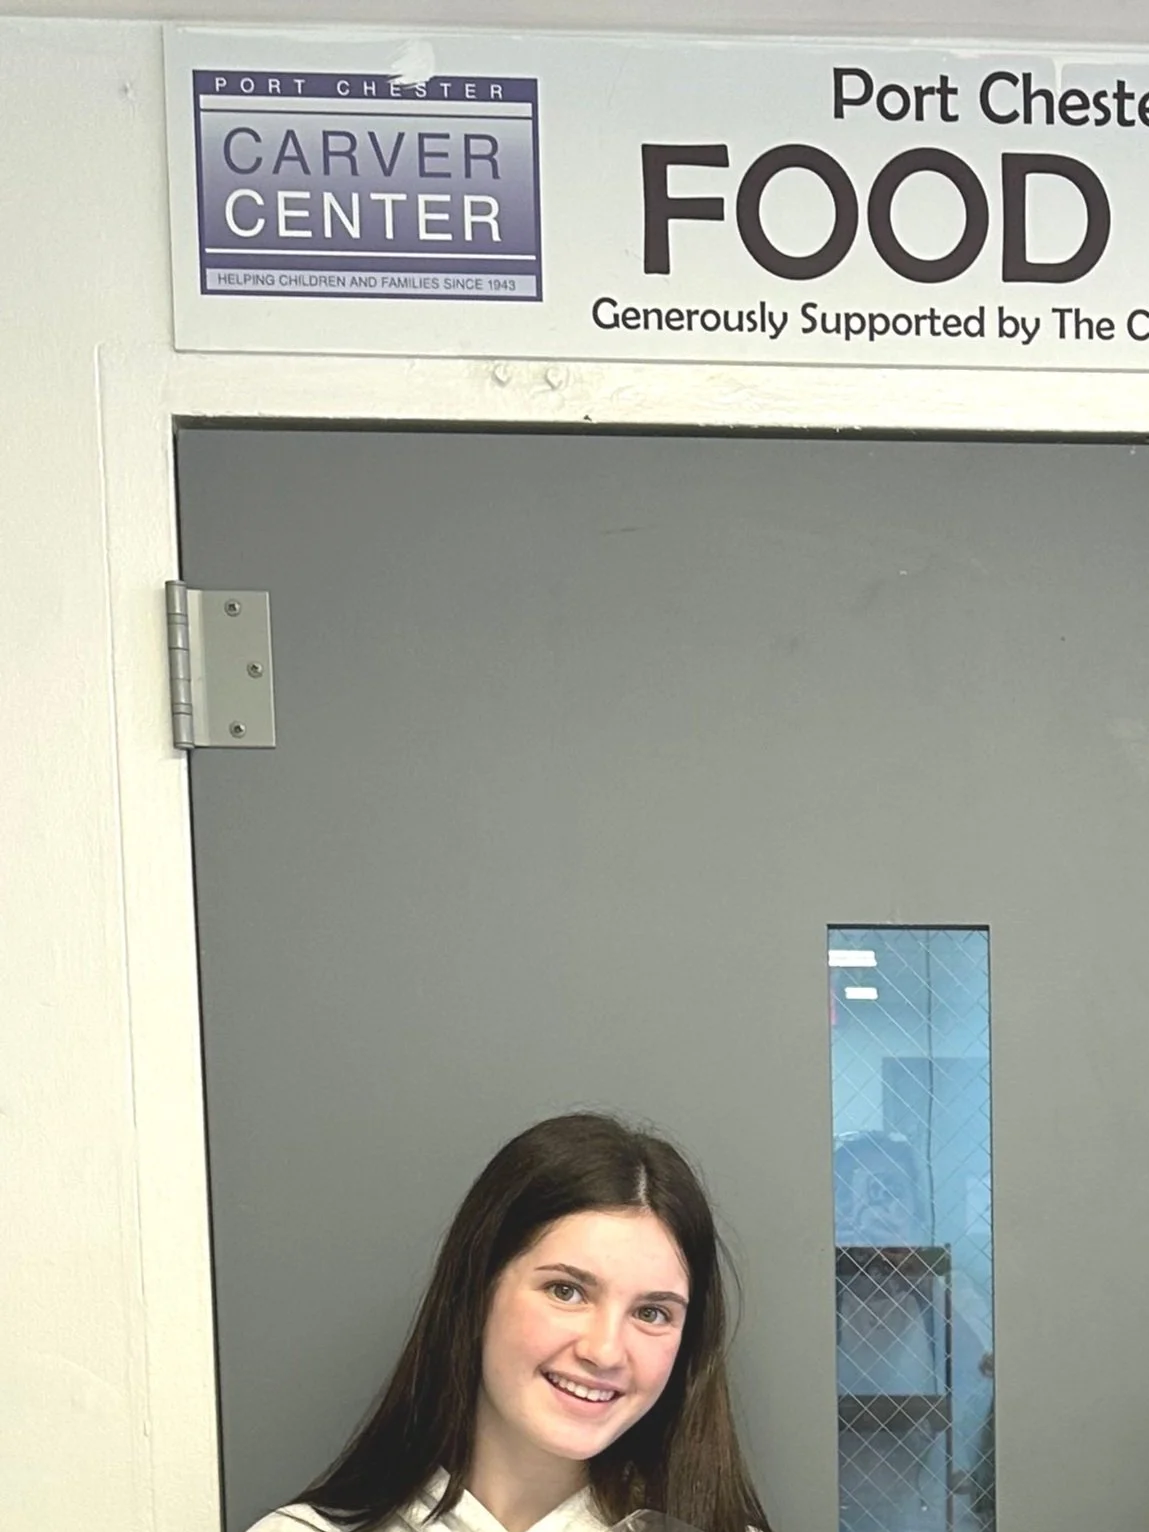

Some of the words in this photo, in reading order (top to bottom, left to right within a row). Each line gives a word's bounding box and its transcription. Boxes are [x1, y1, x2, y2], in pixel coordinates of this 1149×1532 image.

[215, 77, 305, 94] PORT
[336, 80, 503, 99] CHESTER
[833, 67, 958, 122] Port
[223, 127, 501, 180] CARVER
[225, 188, 502, 242] CENTER
[641, 143, 1110, 283] FOOD
[217, 273, 275, 287] HELPING
[278, 274, 345, 288] CHILDREN
[349, 276, 378, 289] AND
[381, 277, 440, 290] FAMILIES
[443, 278, 484, 291] SINCE
[487, 279, 516, 292] 1943
[592, 297, 787, 339] Generously
[800, 302, 984, 341] Supported
[997, 305, 1040, 345] by
[1051, 307, 1114, 340] The
